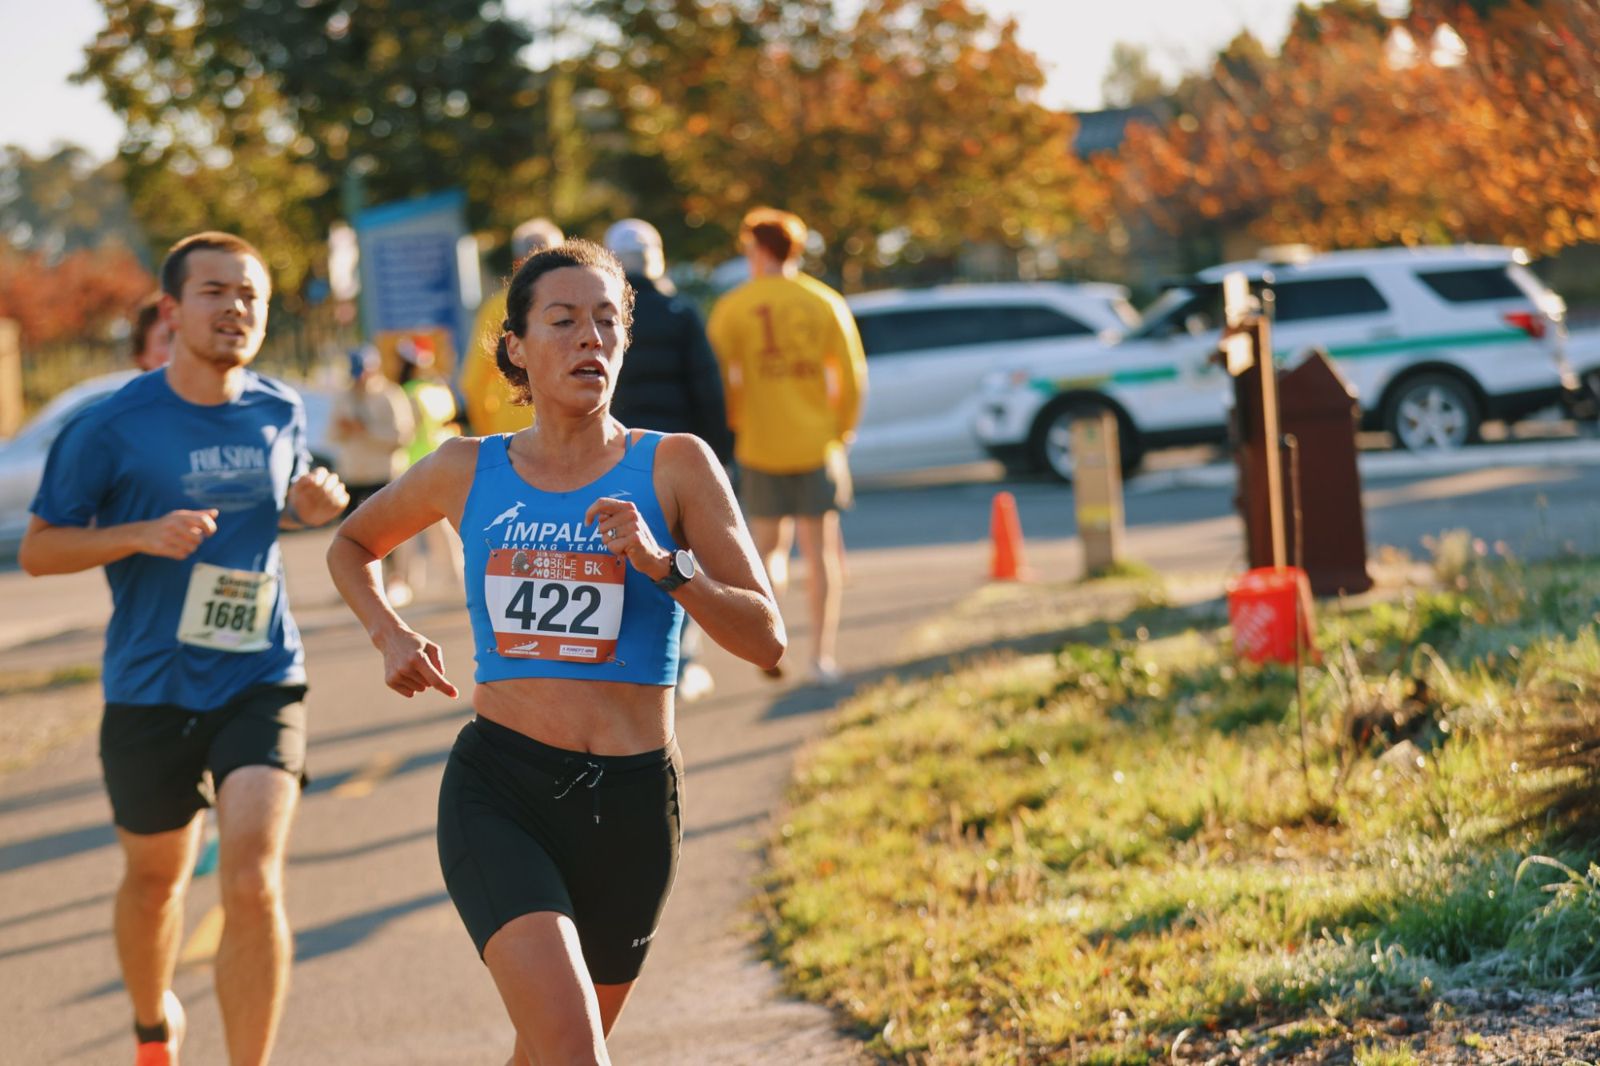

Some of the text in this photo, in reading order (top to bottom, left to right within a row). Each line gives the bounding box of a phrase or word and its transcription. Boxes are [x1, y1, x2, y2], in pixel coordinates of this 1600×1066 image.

[501, 543, 608, 552] RACING TEAM
[533, 557, 603, 576] GOBBLE 5K
[504, 580, 602, 635] 422
